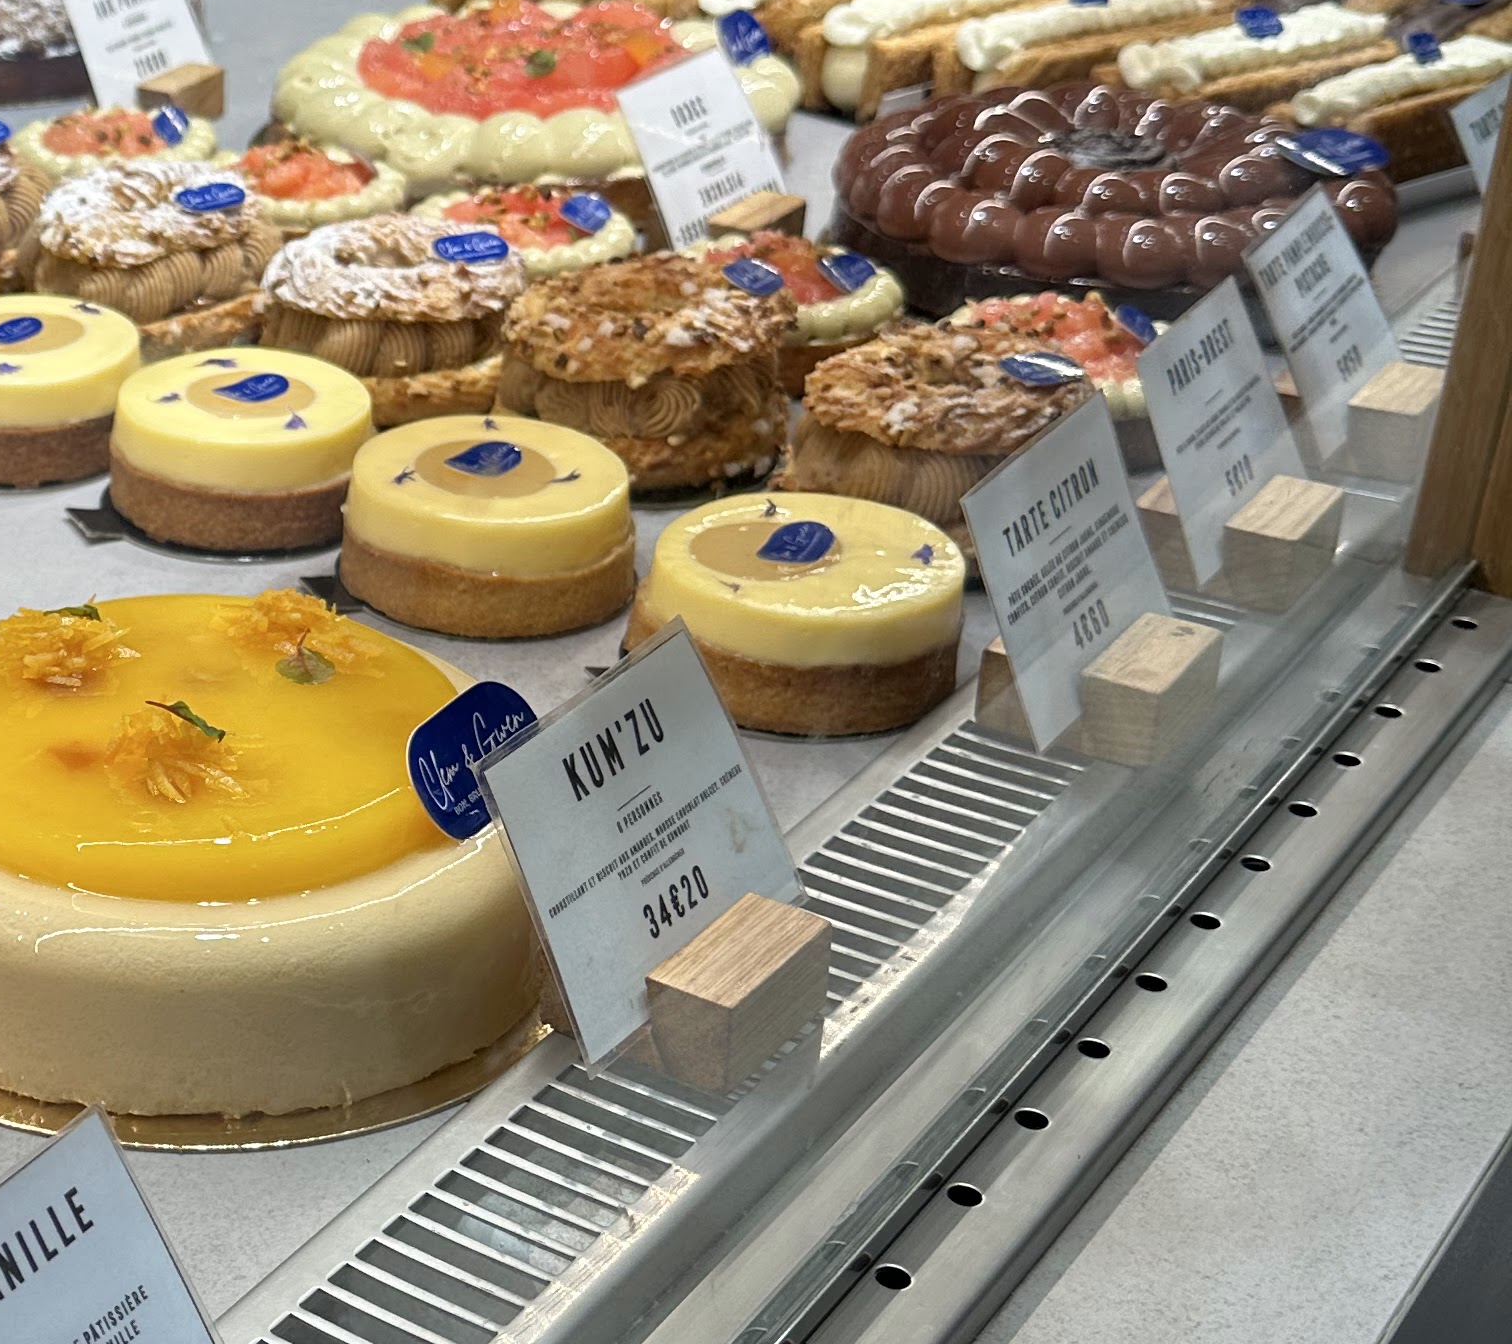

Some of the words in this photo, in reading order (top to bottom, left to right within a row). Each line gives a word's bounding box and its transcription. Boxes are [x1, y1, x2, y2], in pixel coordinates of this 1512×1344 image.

[1165, 317, 1234, 395] PARIS-BREST
[1001, 498, 1050, 557] TARTE
[1048, 457, 1099, 519] CITRON
[1071, 597, 1110, 649] 4€60
[561, 698, 664, 801] KUM'ZU
[622, 790, 663, 828] PERSONNES
[642, 864, 709, 939] 34€20
